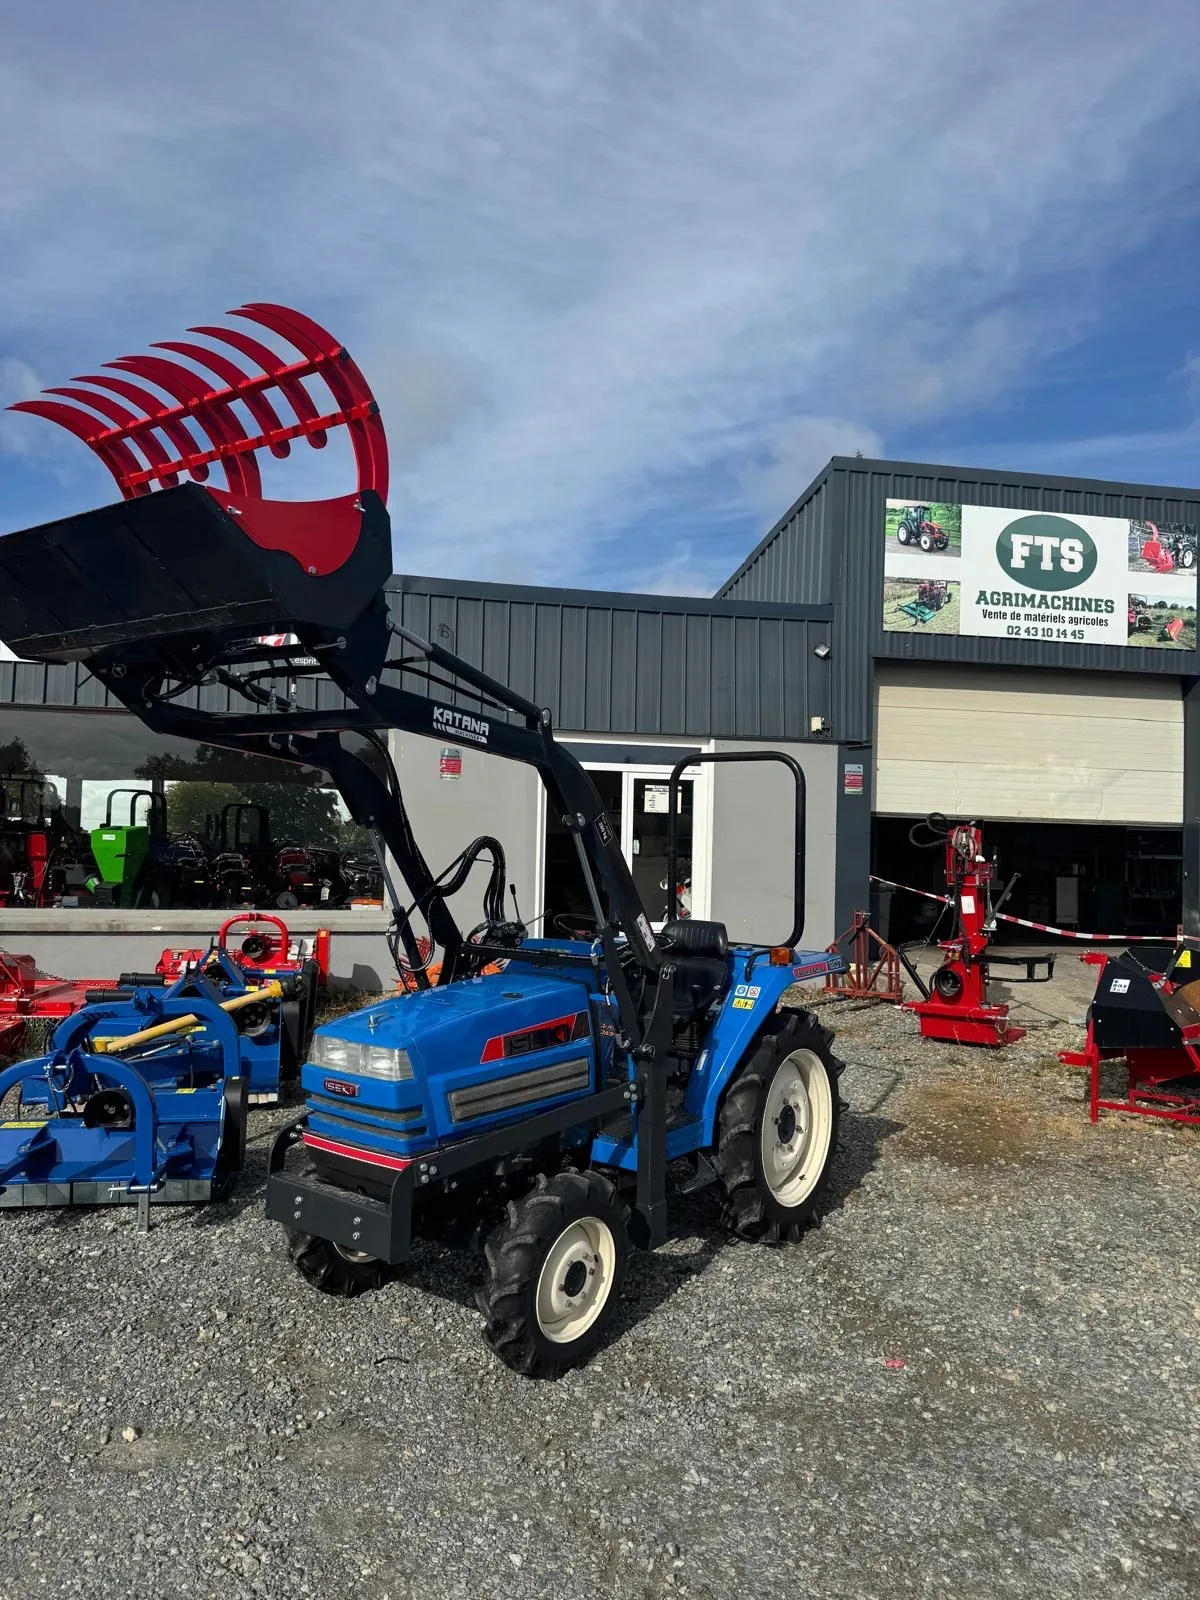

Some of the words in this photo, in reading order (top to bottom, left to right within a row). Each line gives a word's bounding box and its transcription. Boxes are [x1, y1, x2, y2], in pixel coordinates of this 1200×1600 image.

[1010, 533, 1084, 573] FTS
[975, 590, 1115, 613] AGRIMACHINES
[982, 608, 1008, 620] Vente
[1010, 610, 1021, 621] de
[1024, 612, 1066, 624] matériels
[1068, 615, 1109, 627] agricoles
[1007, 625, 1021, 636] 02
[1024, 626, 1038, 637] 43
[1041, 627, 1053, 638] 10
[1056, 628, 1068, 639] 14
[1070, 629, 1085, 640] 45
[433, 705, 489, 736] KATANA
[325, 1081, 354, 1095] ISEKI
